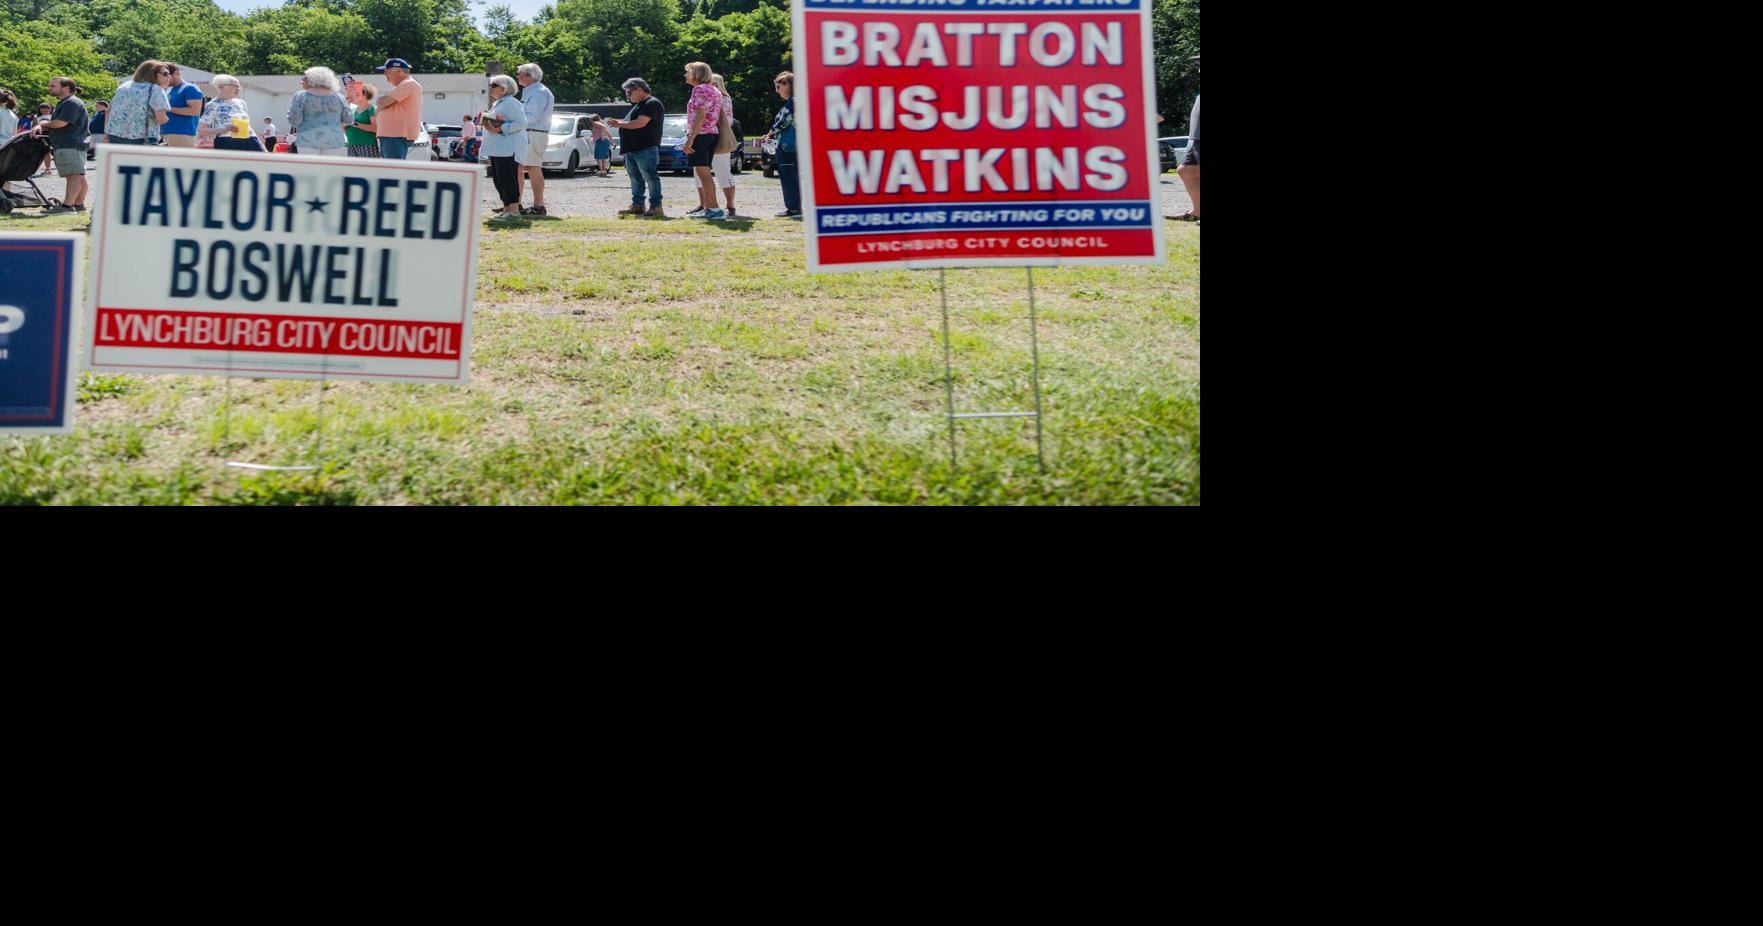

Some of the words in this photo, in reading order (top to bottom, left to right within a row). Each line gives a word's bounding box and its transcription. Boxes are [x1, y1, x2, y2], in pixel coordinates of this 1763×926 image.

[821, 21, 1124, 66] BRATTON
[825, 84, 1127, 131] MISJUNS
[828, 146, 1128, 195] WATKINS
[117, 164, 296, 233] TAYLOR
[338, 176, 464, 241] REED
[821, 210, 947, 228] REPUBLICANS
[951, 208, 1049, 224] FIGHTING
[1053, 207, 1095, 222] FOR
[1100, 207, 1145, 221] YOU
[857, 237, 959, 254] LYNCHBURG
[964, 237, 1010, 249] CITY
[1016, 235, 1109, 249] COUNCIL
[169, 239, 399, 307] BOSWELL
[99, 312, 272, 348] LYNCHBURG
[275, 319, 337, 349] CITY
[338, 322, 458, 356] COUNCIL
